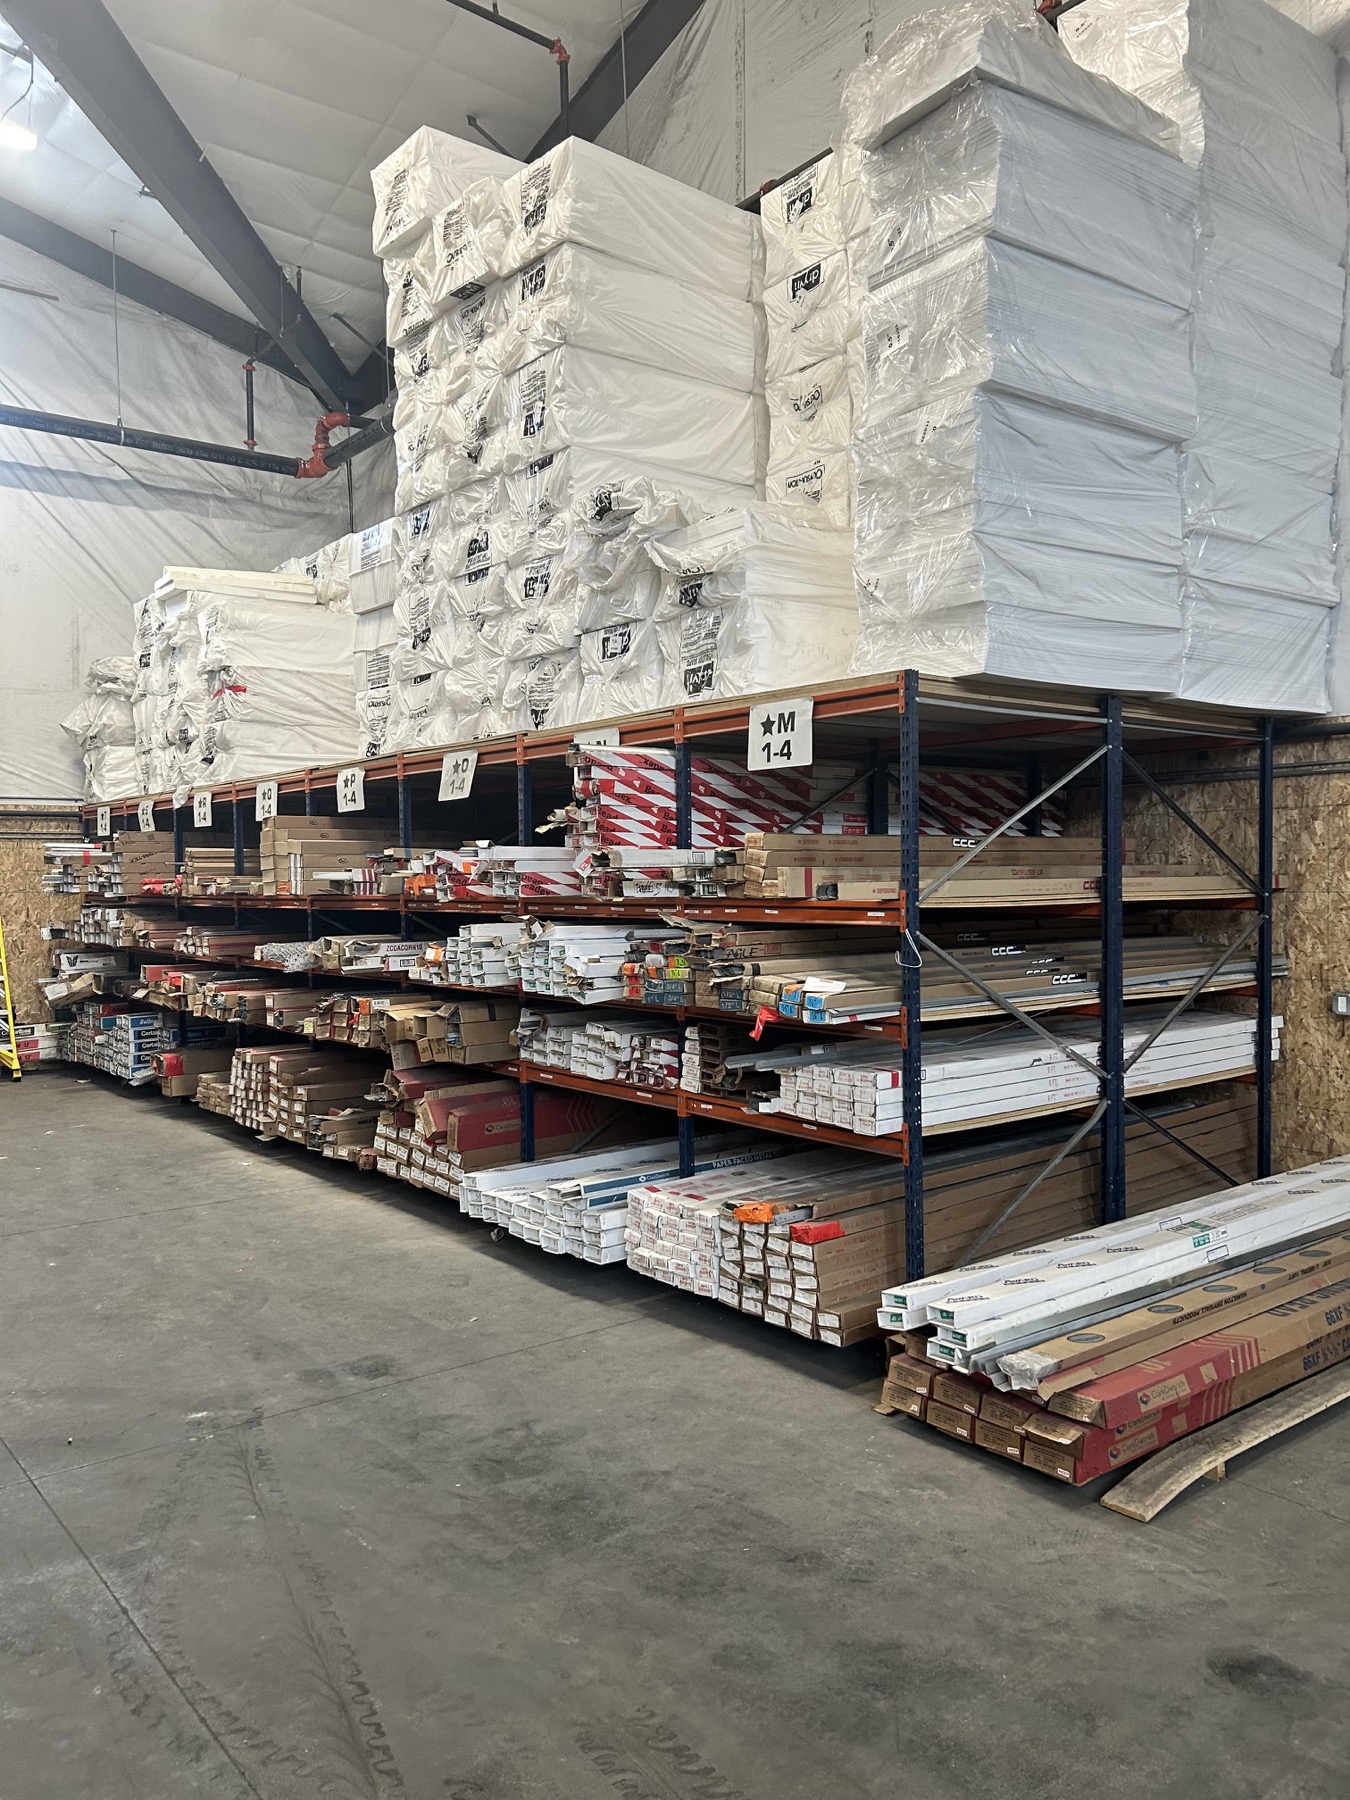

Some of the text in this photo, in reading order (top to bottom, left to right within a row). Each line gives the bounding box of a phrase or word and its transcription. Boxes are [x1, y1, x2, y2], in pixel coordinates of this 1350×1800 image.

[778, 711, 796, 734] M
[762, 739, 792, 763] 1-4
[350, 773, 356, 787] P
[450, 778, 466, 794] 1-4
[267, 788, 272, 800] Q
[343, 791, 356, 806] 1-4
[202, 796, 207, 808] R
[261, 804, 272, 816] 1-4
[198, 812, 206, 822] 1-4
[991, 946, 1024, 956] CCC
[1052, 974, 1084, 985] CCC
[712, 1156, 752, 1169] PAPER-FACED
[1201, 1300, 1224, 1314] DRYWALL
[1172, 1309, 1200, 1326] PRODUCTS
